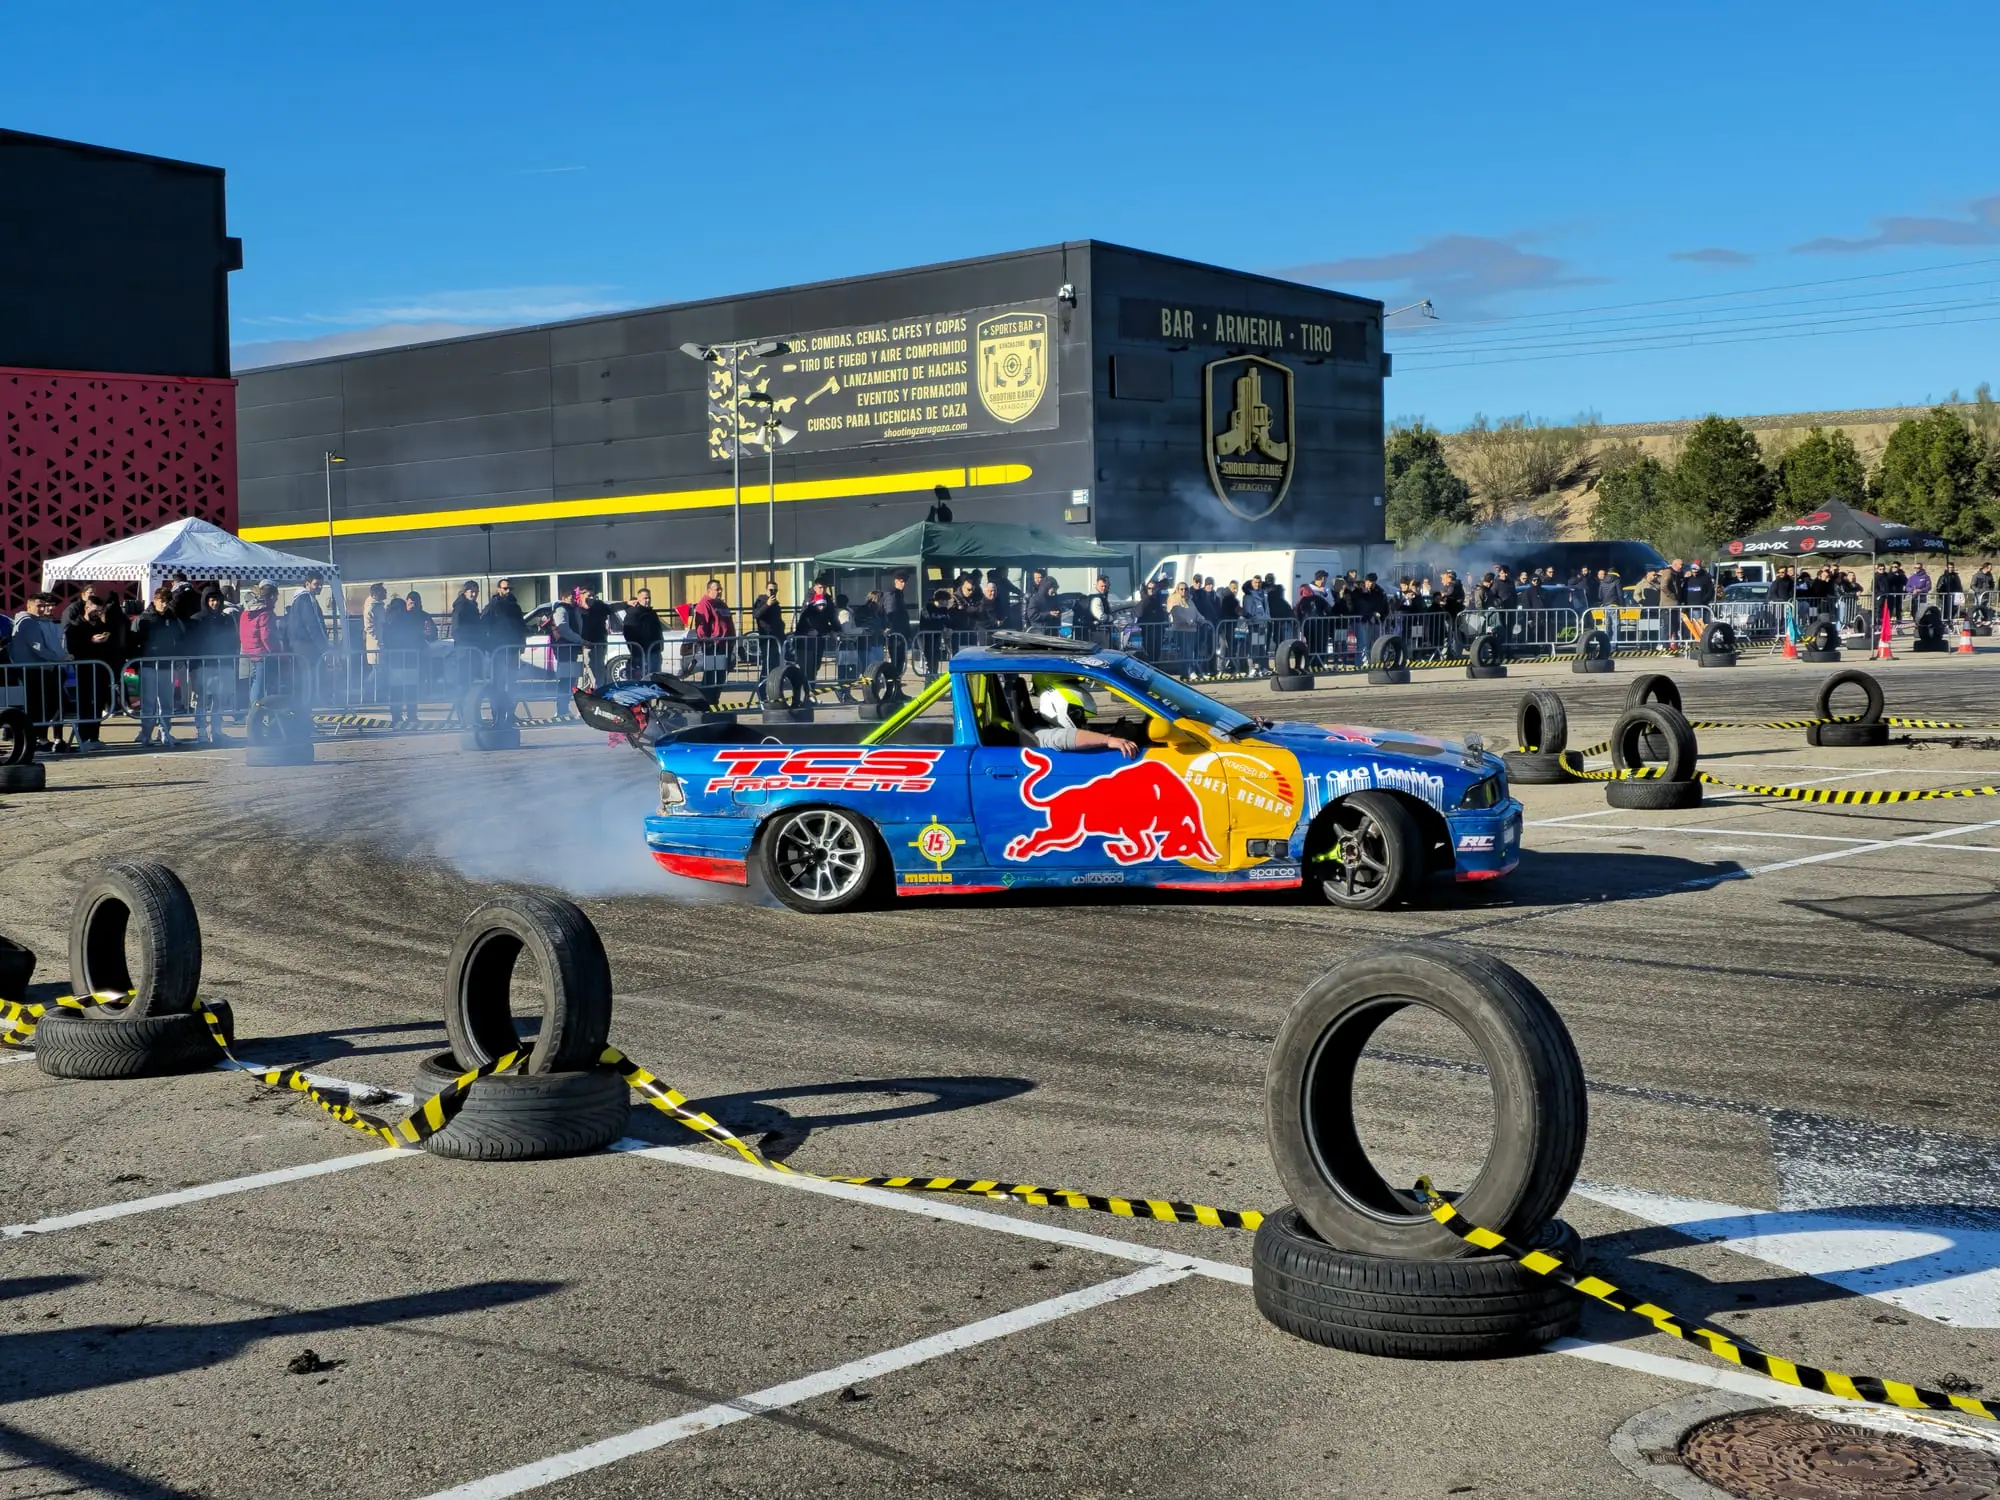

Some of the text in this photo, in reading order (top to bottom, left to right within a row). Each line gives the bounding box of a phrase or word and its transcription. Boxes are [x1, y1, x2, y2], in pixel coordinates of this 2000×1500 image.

[811, 333, 855, 351] COMIDAS,
[857, 328, 890, 345] CENAS,
[892, 323, 922, 341] CAFES
[925, 323, 932, 337] Y
[935, 318, 967, 335] COPAS
[990, 320, 1033, 336] SPORTS BAR
[1162, 308, 1332, 352] BAR ARMERIA TIRO
[800, 339, 967, 373] TIRO DE FUEGO Y AIRE COMPRIMIDO
[843, 360, 967, 388] LANZAMIENTO DE HACHAS
[857, 382, 968, 407] EVENTOS Y FORMACION
[808, 403, 968, 432] CURSOS PARA LICENCIAS DE CAZA
[883, 421, 968, 438] shootingzaragoza.com
[1222, 462, 1283, 477] SHOOTING RANGE
[1744, 539, 1864, 551] 24MX 24MX
[713, 748, 945, 777] TCS
[704, 775, 937, 794] PROJECTS
[1184, 769, 1293, 818] BONET REMAPS
[926, 833, 945, 852] 15
[1249, 868, 1295, 880] sparco
